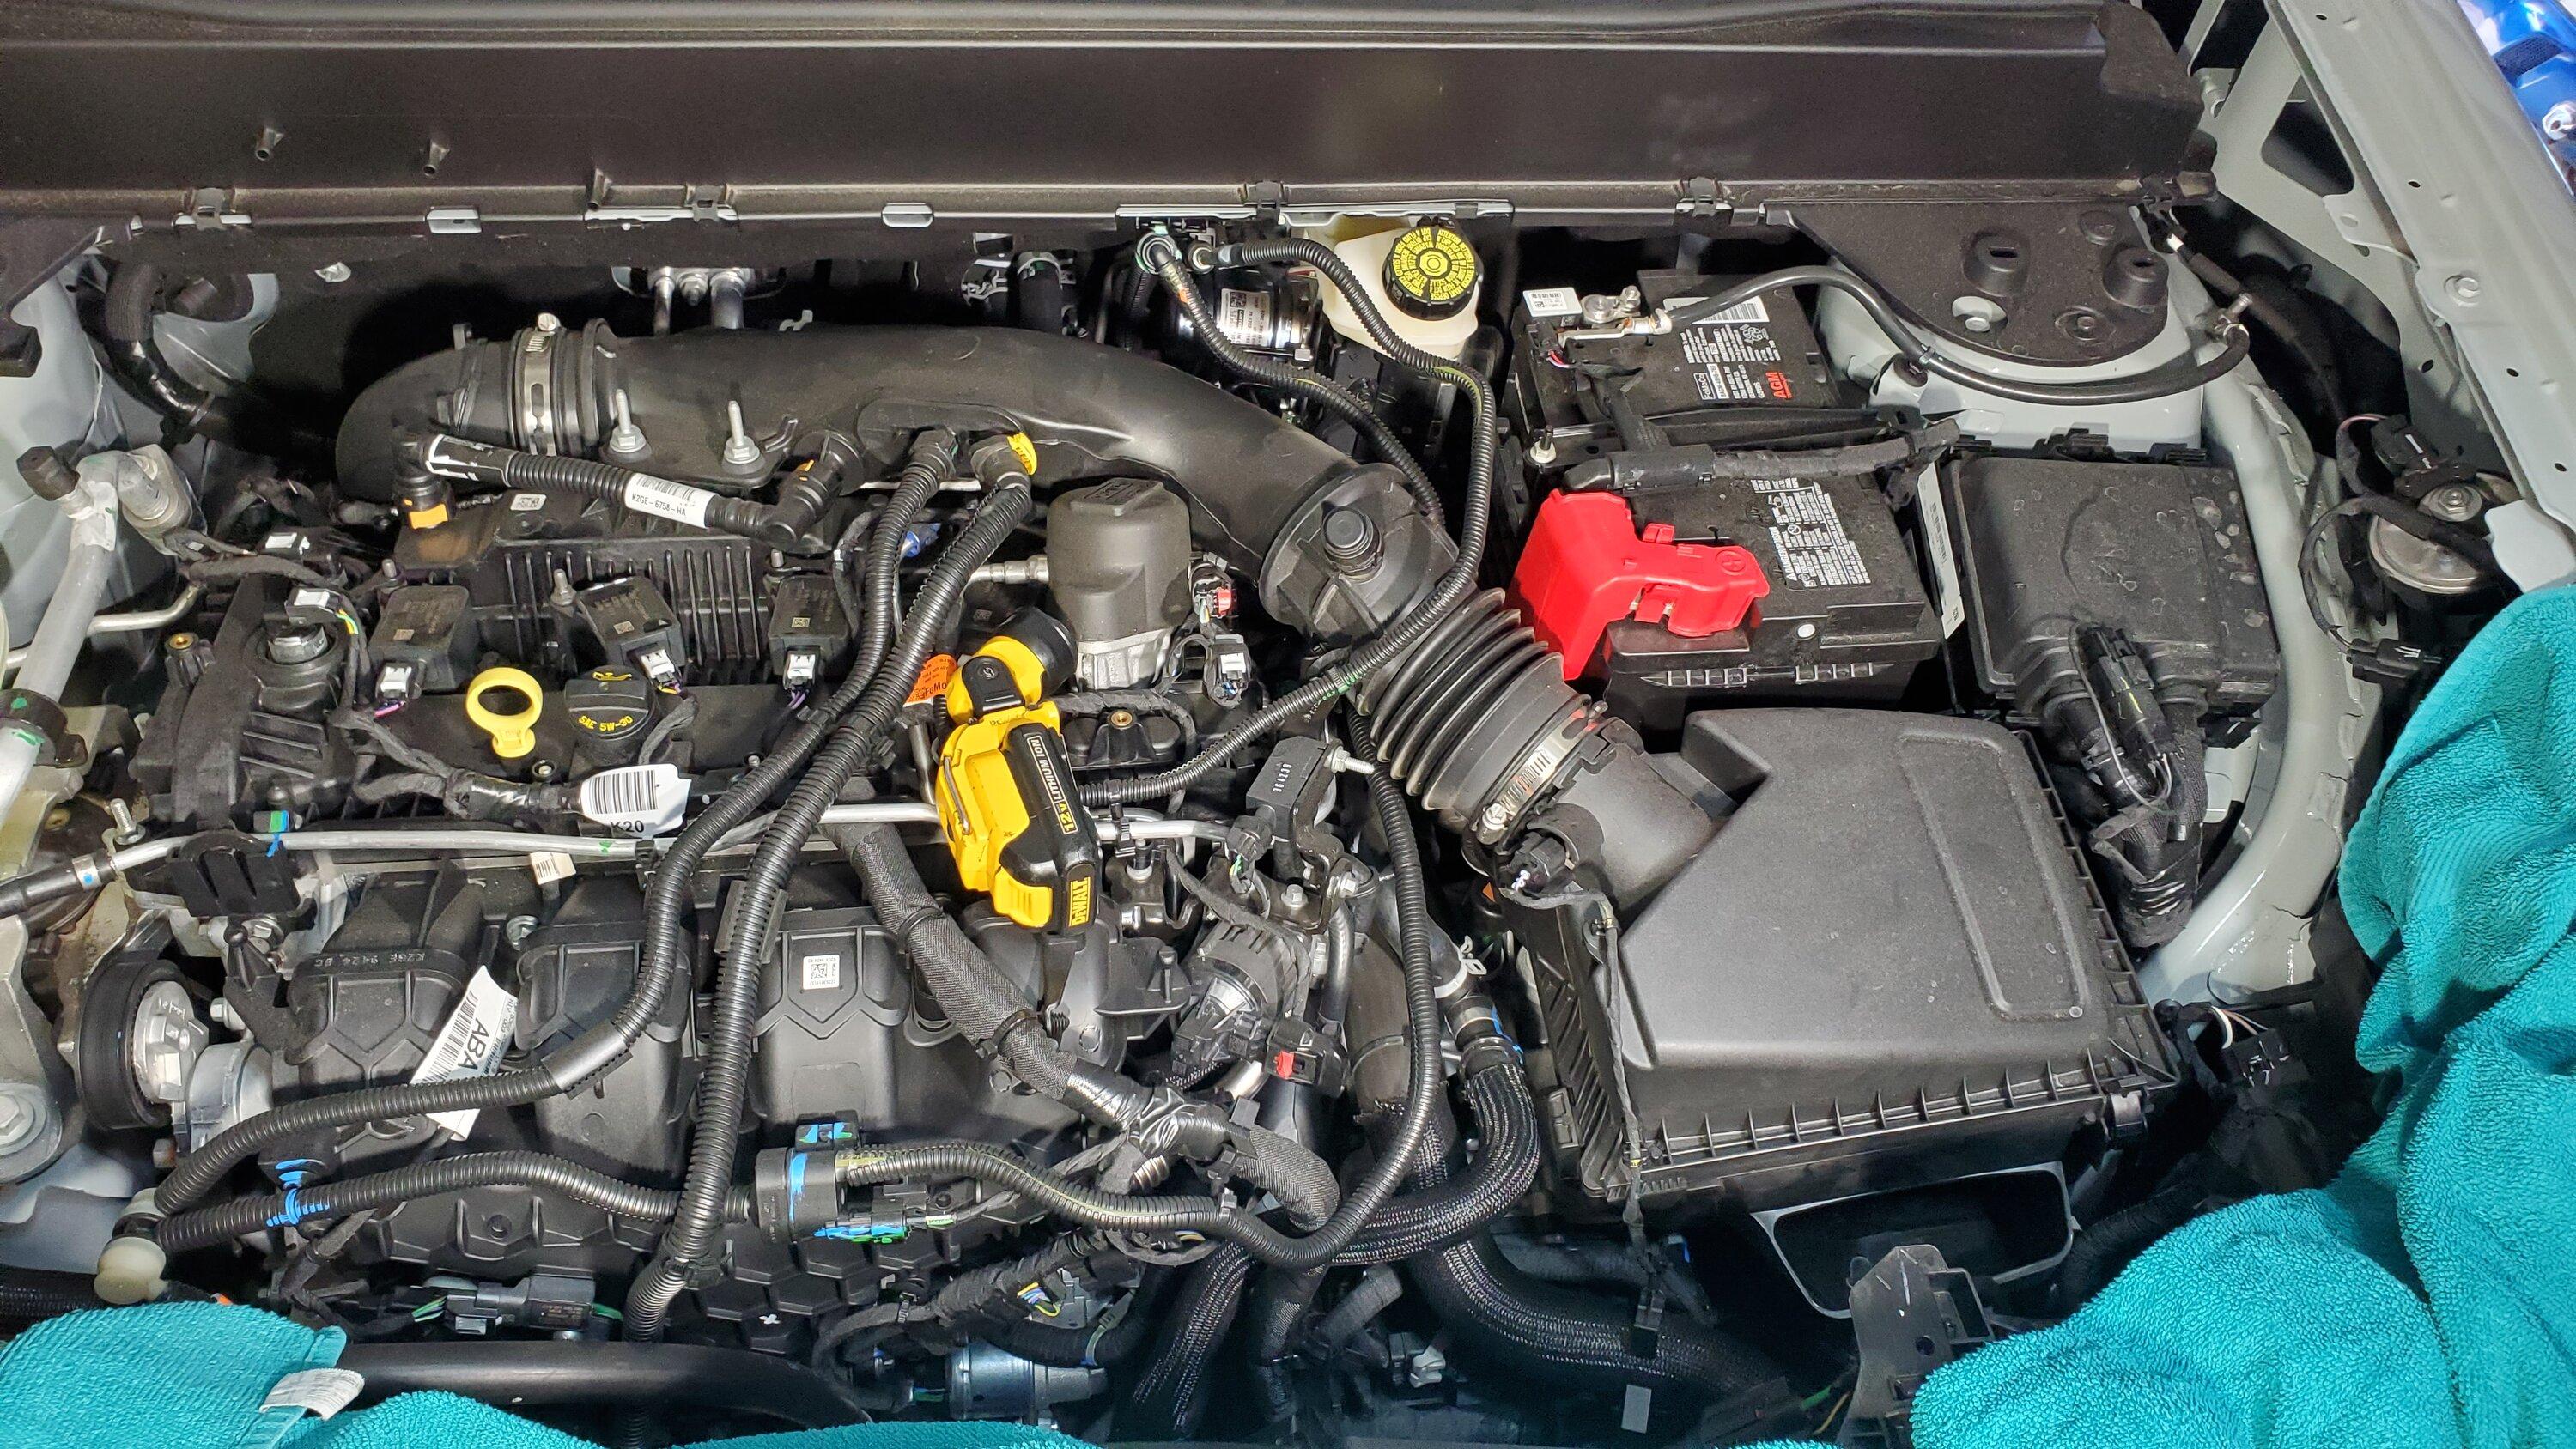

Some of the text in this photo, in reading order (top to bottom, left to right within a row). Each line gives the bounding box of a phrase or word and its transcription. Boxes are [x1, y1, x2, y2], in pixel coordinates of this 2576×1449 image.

[1766, 372, 1787, 398] AGM
[579, 715, 633, 731] SAE 5W-30
[1030, 739, 1044, 759] ION
[1039, 761, 1061, 803] LITHIUM
[611, 820, 645, 833] K20
[458, 1017, 490, 1070] ABA
